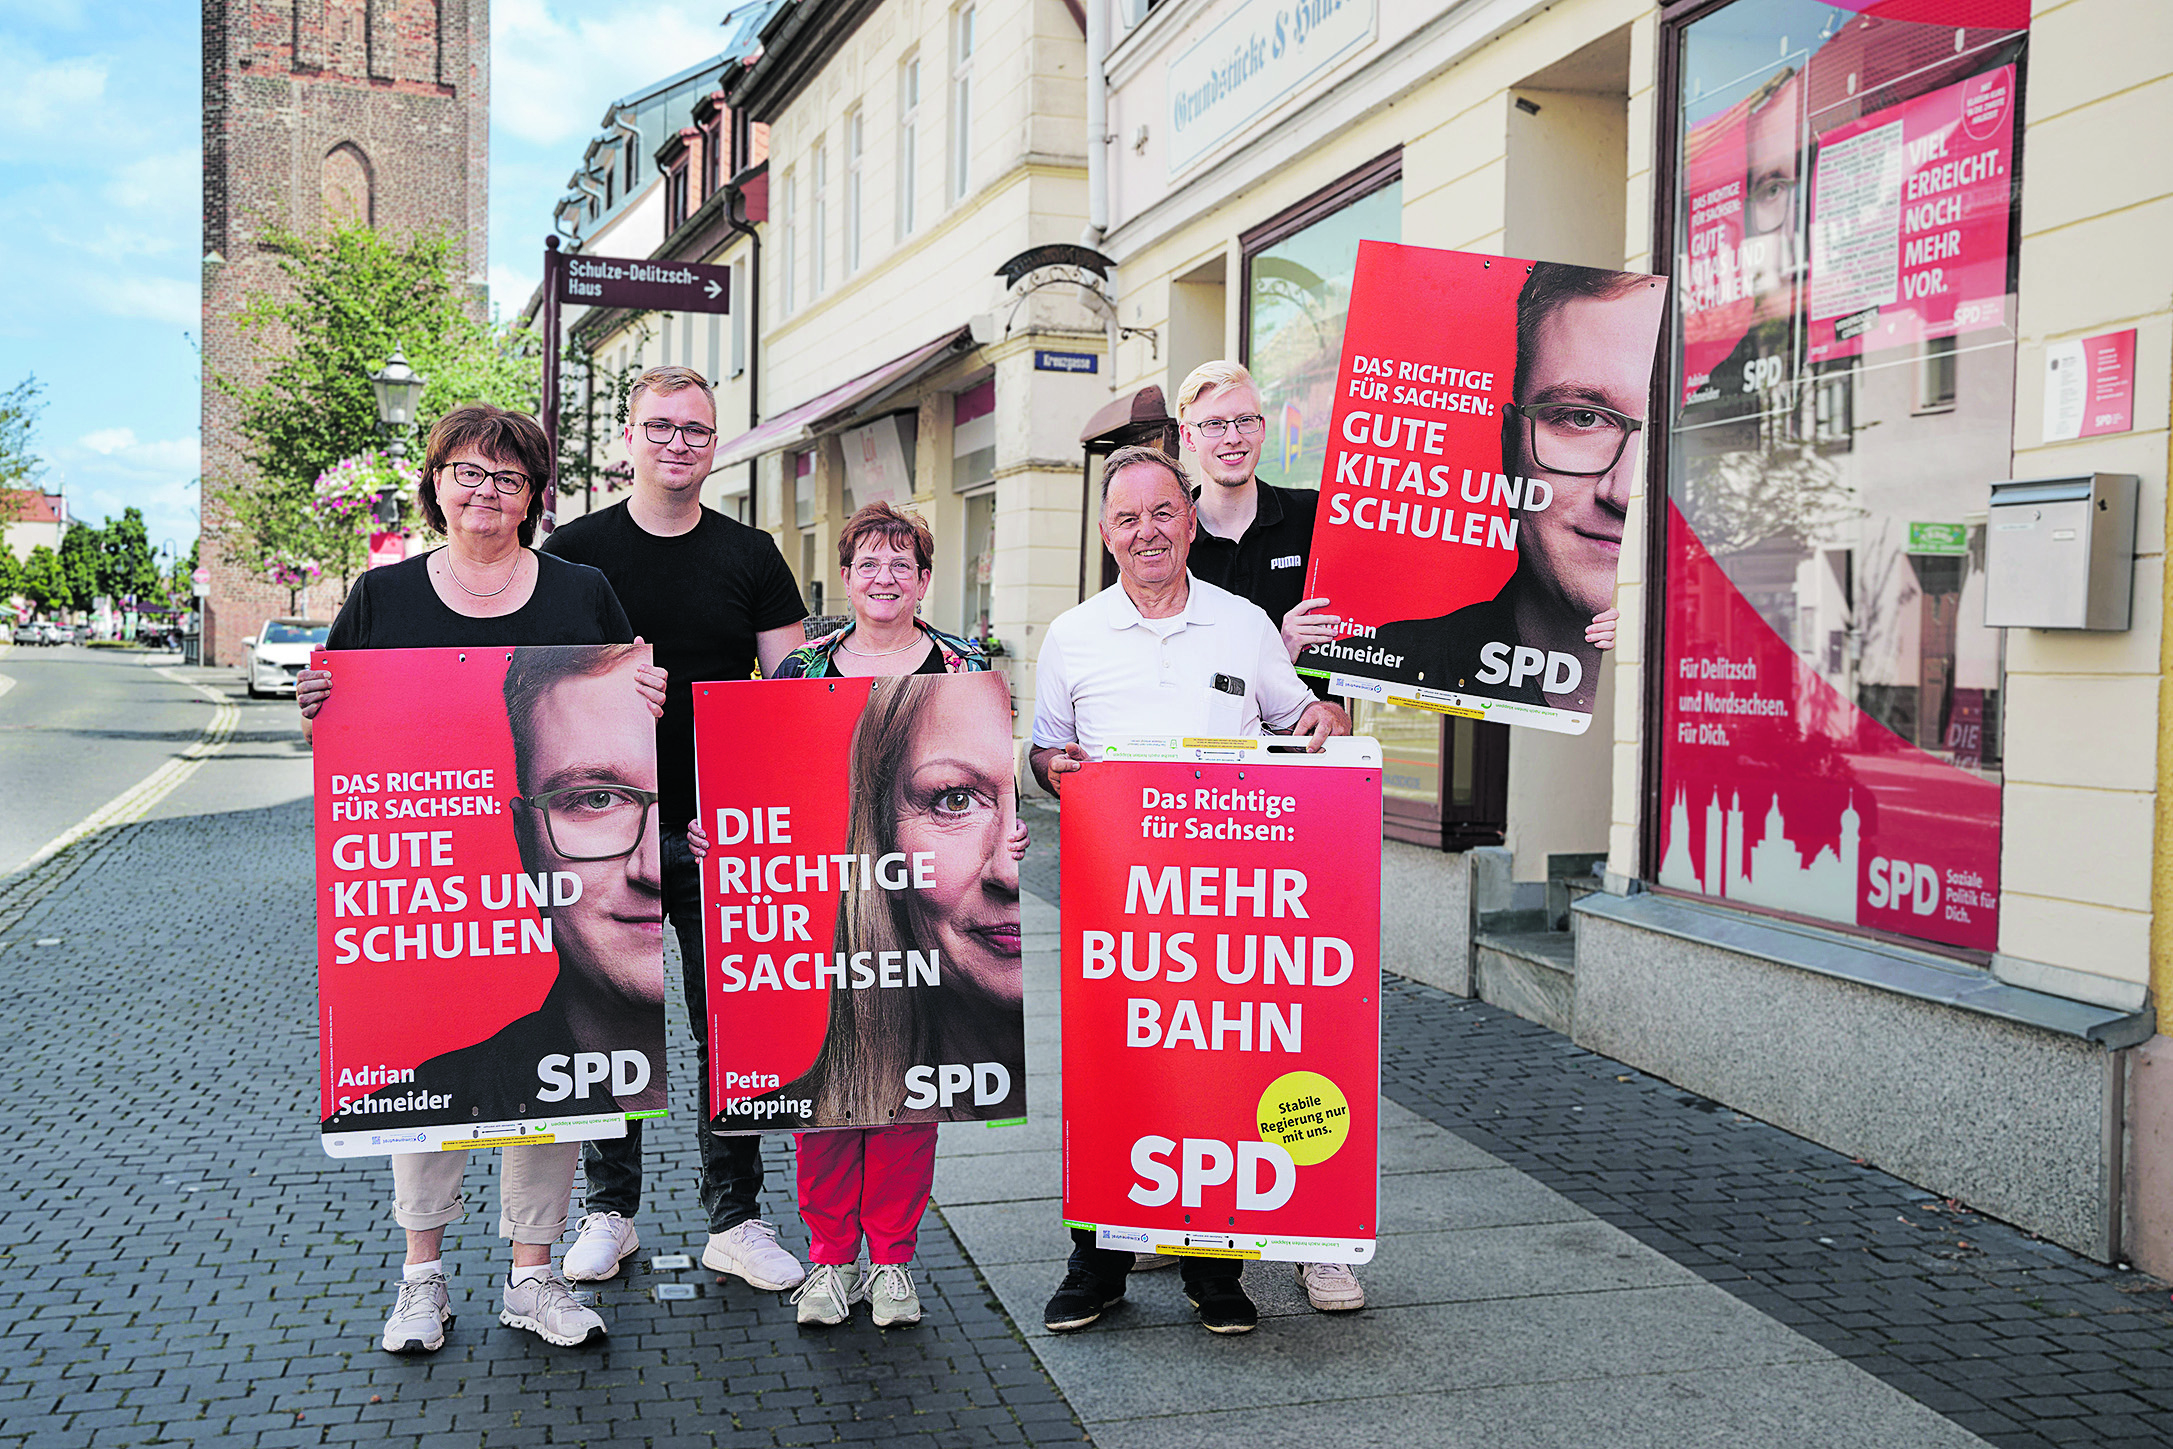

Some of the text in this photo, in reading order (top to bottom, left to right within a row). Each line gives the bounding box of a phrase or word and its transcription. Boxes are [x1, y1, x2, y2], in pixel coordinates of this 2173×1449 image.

[1909, 132, 1948, 166] VIEL
[1907, 148, 2004, 200] ERREICHT.
[1905, 195, 1962, 234] NOCH
[1691, 224, 1726, 257] GUTE
[1904, 230, 1961, 268] MEHR
[569, 260, 699, 284] Schulze-Delitzsch-
[569, 278, 602, 296] Haus
[1903, 271, 1948, 300] VOR.
[1953, 305, 1980, 326] SPD
[1352, 355, 1493, 391] DAS RICHTIGE
[1743, 355, 1782, 393] SPD
[1348, 376, 1495, 417] FÜR SACHSEN:
[1342, 410, 1448, 456] GUTE
[1335, 452, 1554, 512] KITAS UND
[1329, 493, 1519, 550] SCHULEN
[1271, 555, 1301, 570] PUMA
[1474, 641, 1583, 695] SPD
[1680, 658, 1756, 680] Für Delitzsch
[1679, 692, 1788, 717] und Nordsachsen.
[1678, 723, 1729, 746] Für Dich.
[1948, 723, 1979, 749] DIE
[331, 769, 494, 795] DAS RICHTIGE
[332, 795, 502, 822] FÜR SACHSEN:
[1142, 787, 1296, 819] Das Richtige
[716, 806, 792, 845] DIE
[1141, 817, 1295, 842] für Sachsen:
[332, 830, 454, 871] GUTE
[719, 851, 936, 893] RICHTIGE
[1867, 857, 1940, 916] SPD
[1946, 869, 1982, 889] Soziale
[334, 871, 582, 918] KITAS UND
[1124, 865, 1310, 919] MEHR
[1946, 888, 1996, 910] Politik für
[720, 894, 813, 943] FÜR
[1946, 905, 1971, 923] Dich.
[334, 917, 553, 965] SCHULEN
[722, 949, 940, 992] SACHSEN
[1082, 930, 1354, 987] BUS UND
[1126, 998, 1303, 1053] BAHN
[337, 1064, 415, 1088] Adrian
[535, 1049, 651, 1103] SPD
[725, 1070, 780, 1089] Petra
[903, 1062, 1011, 1110] SPD
[338, 1089, 452, 1116] Schneider
[726, 1094, 813, 1120] Köpping
[1278, 1095, 1322, 1115] Stabile
[551, 1119, 571, 1128] klappen
[602, 1116, 620, 1124] Lasche
[1260, 1105, 1346, 1134] Regierung nur
[1282, 1125, 1332, 1143] mit uns.
[1127, 1135, 1297, 1211] SPD
